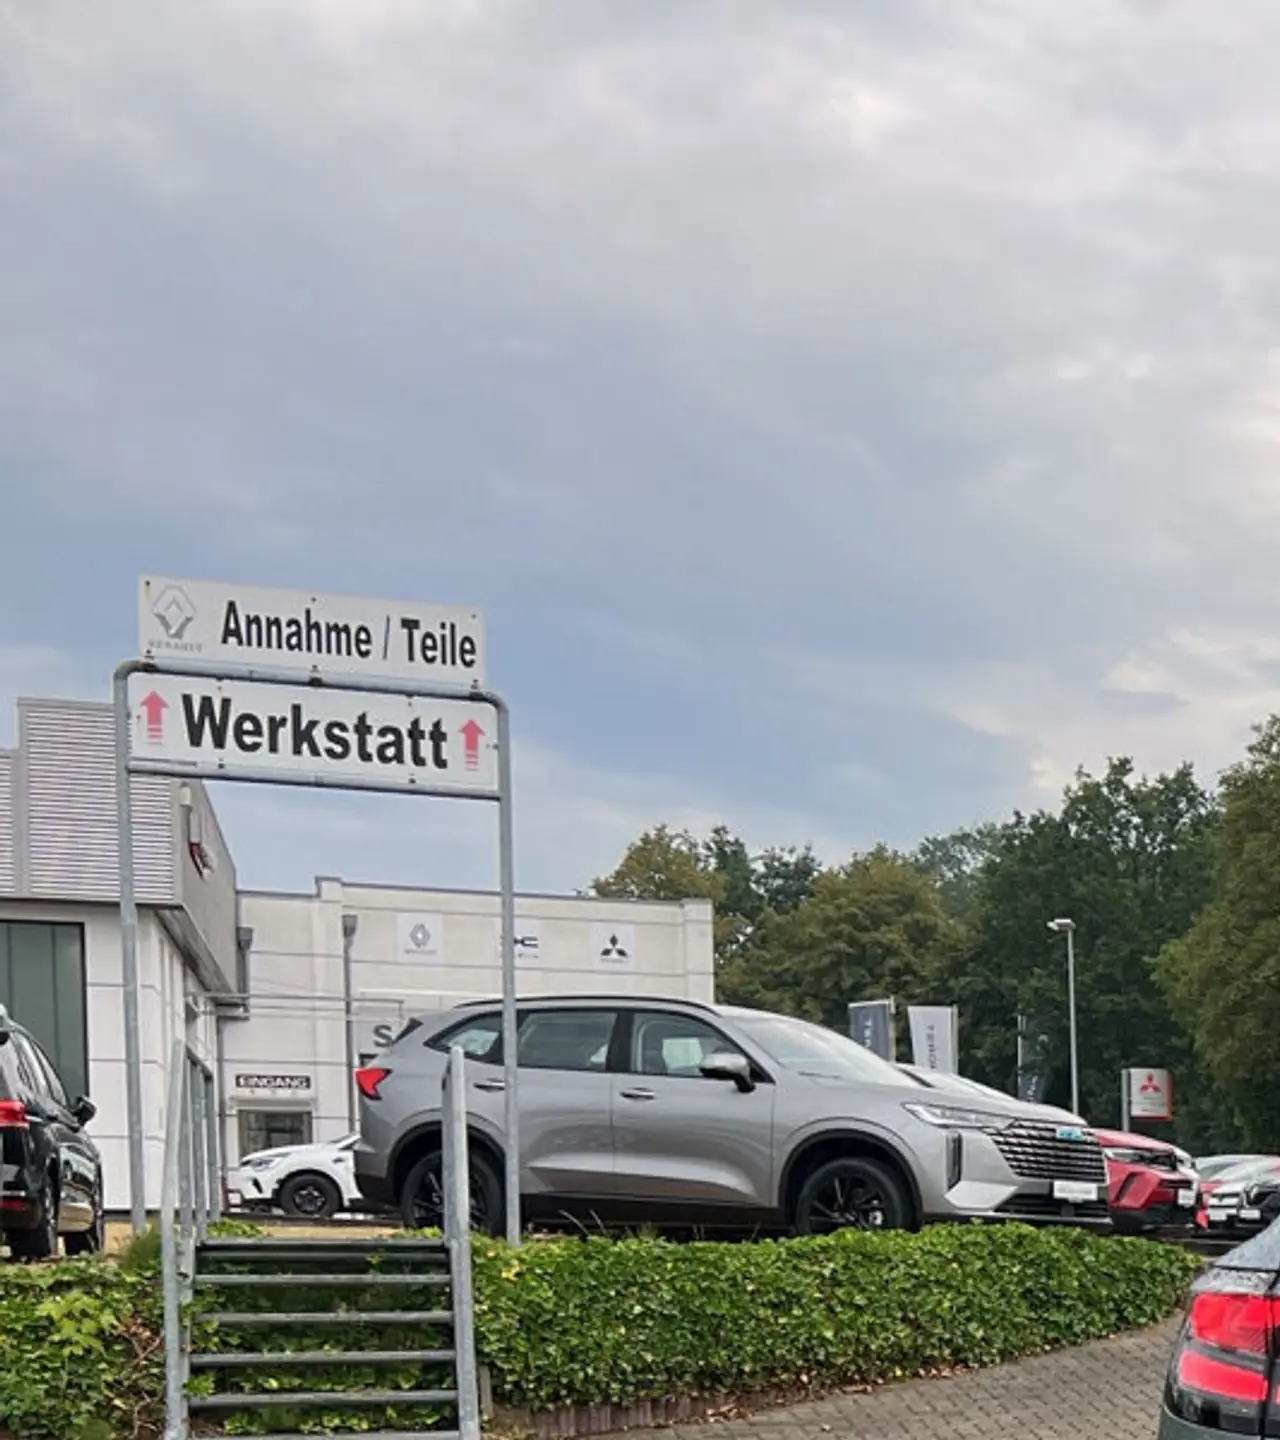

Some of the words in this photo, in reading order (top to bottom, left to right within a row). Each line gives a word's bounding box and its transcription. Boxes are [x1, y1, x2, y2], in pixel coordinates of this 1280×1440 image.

[220, 600, 373, 659] Annahme
[382, 614, 391, 661] /
[400, 616, 477, 668] Teile
[181, 693, 448, 770] Werkstatt
